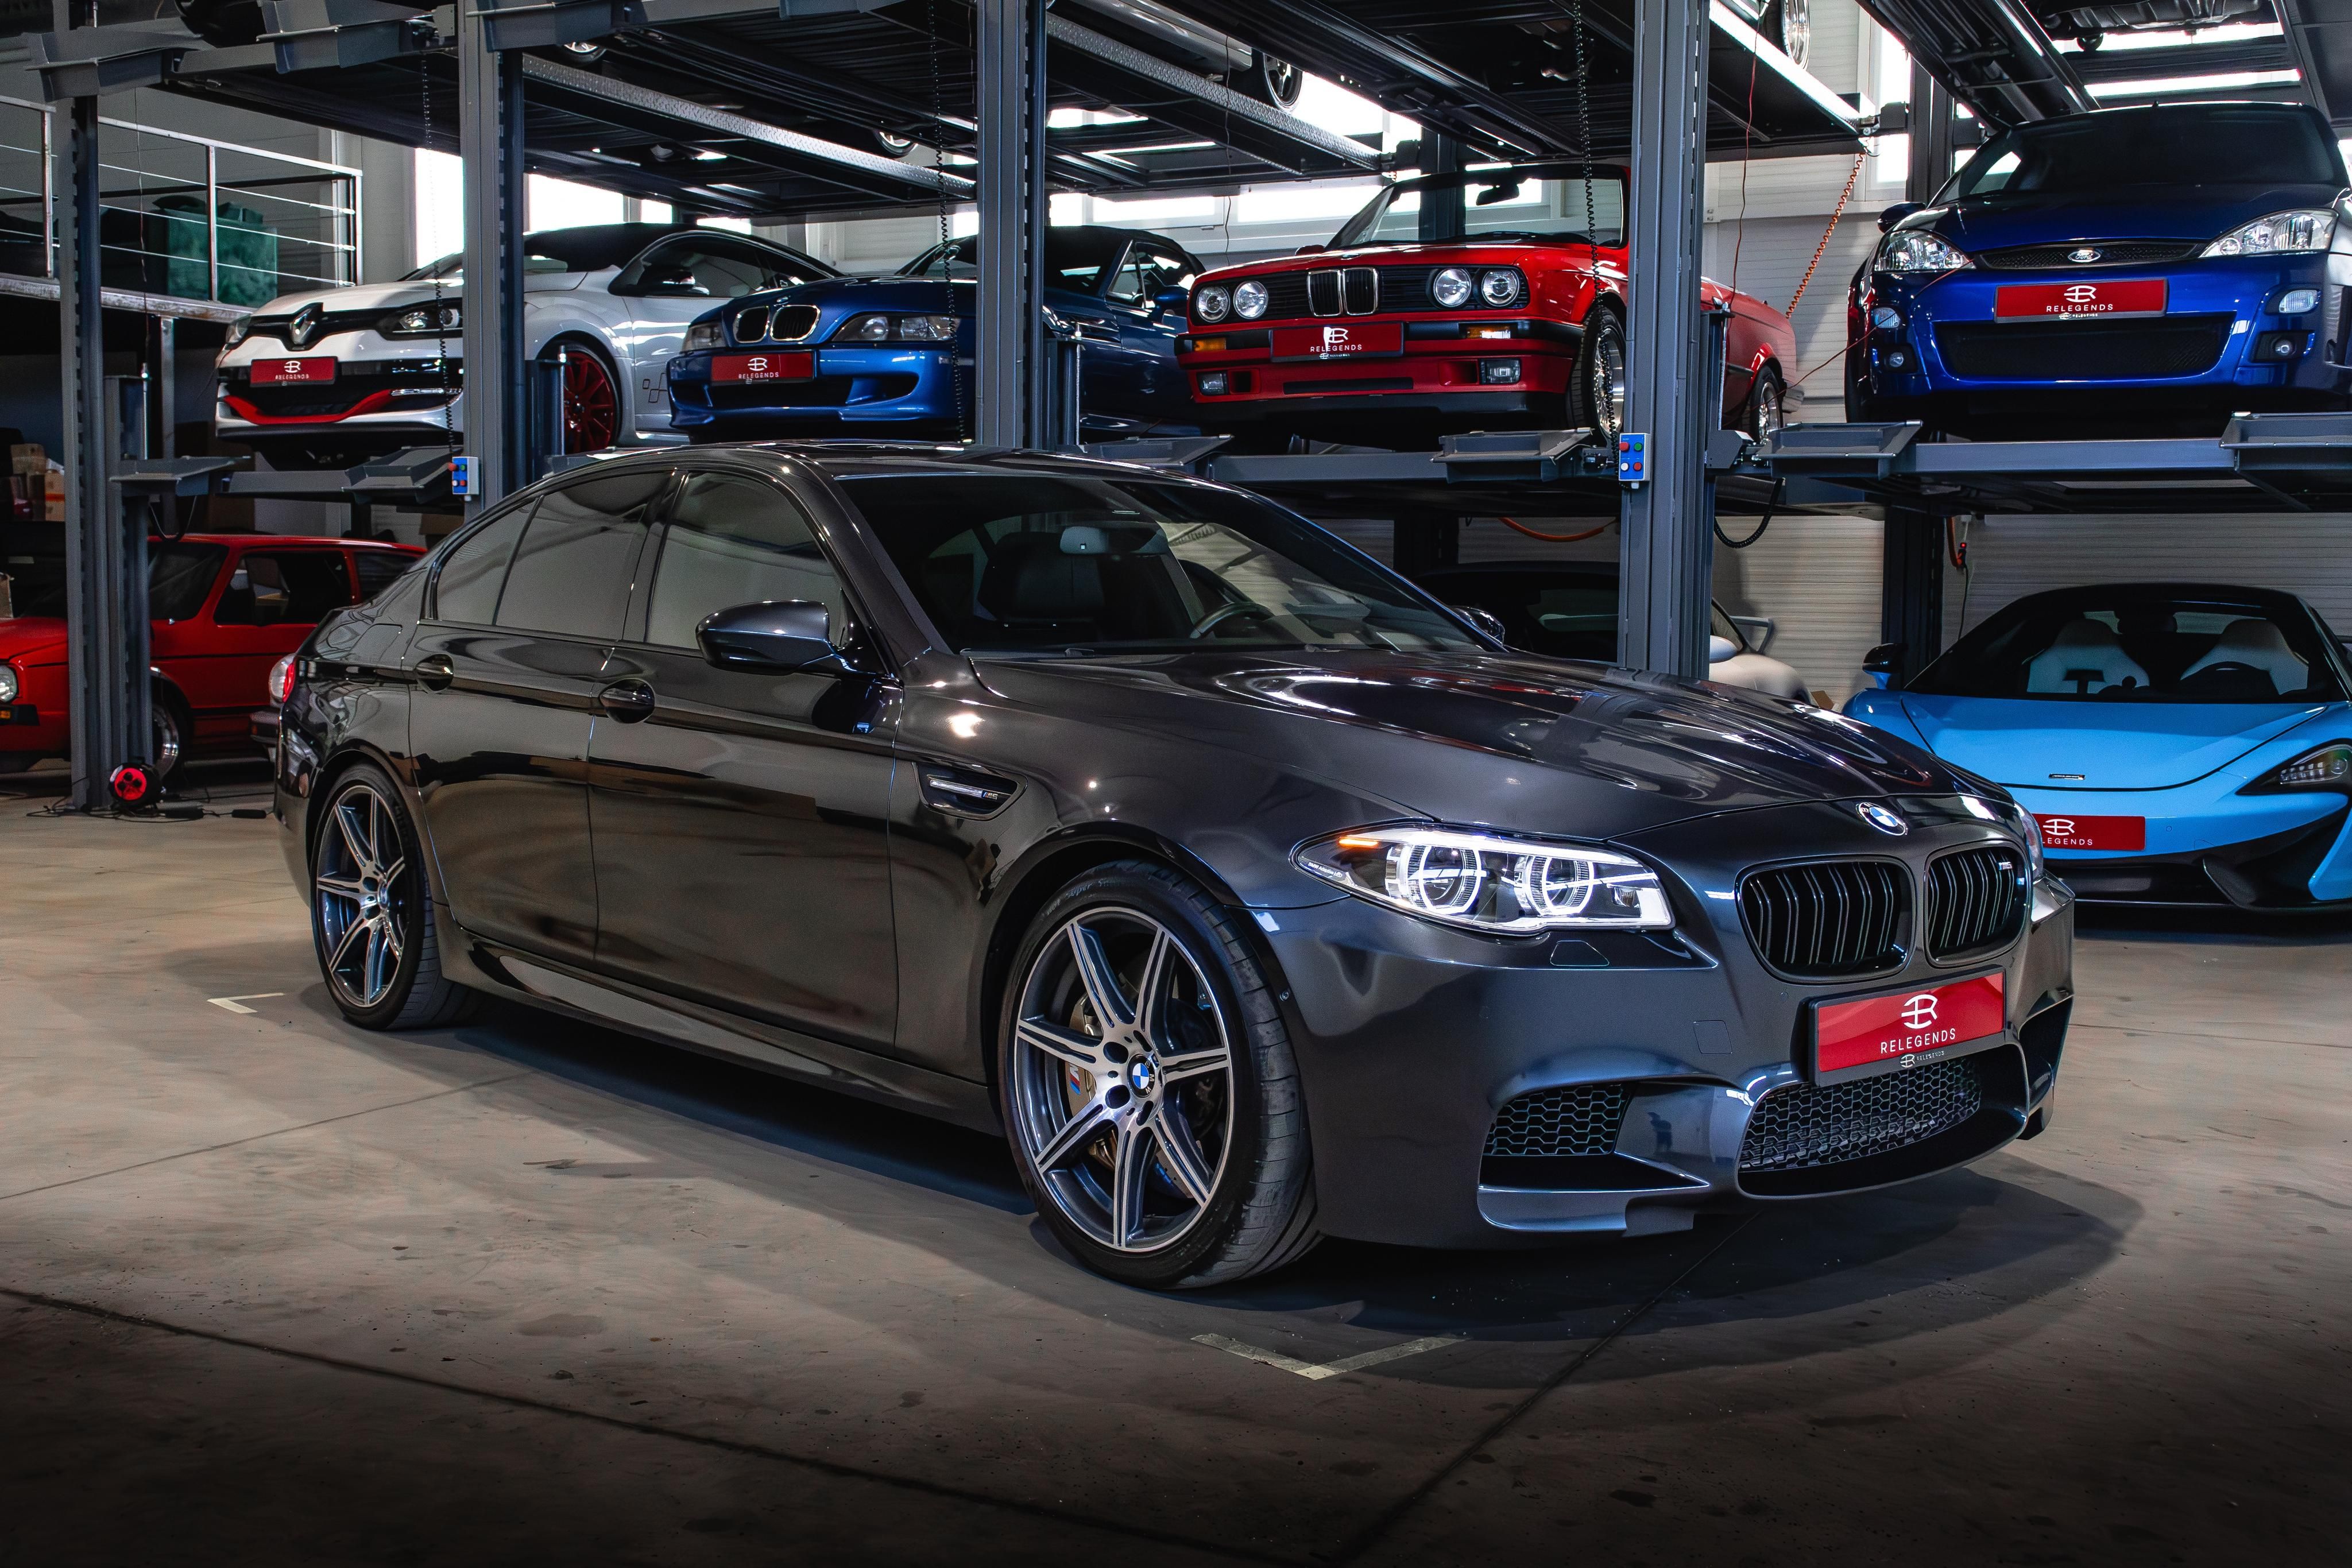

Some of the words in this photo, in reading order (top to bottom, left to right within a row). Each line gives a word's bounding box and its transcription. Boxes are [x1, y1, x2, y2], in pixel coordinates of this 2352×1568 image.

[2046, 304, 2114, 312] RELEGENDS
[2042, 838, 2093, 846] EGENDS
[1881, 1028, 1956, 1054] RELEGENDS
[1916, 1051, 1945, 1060] RELEGENDS
